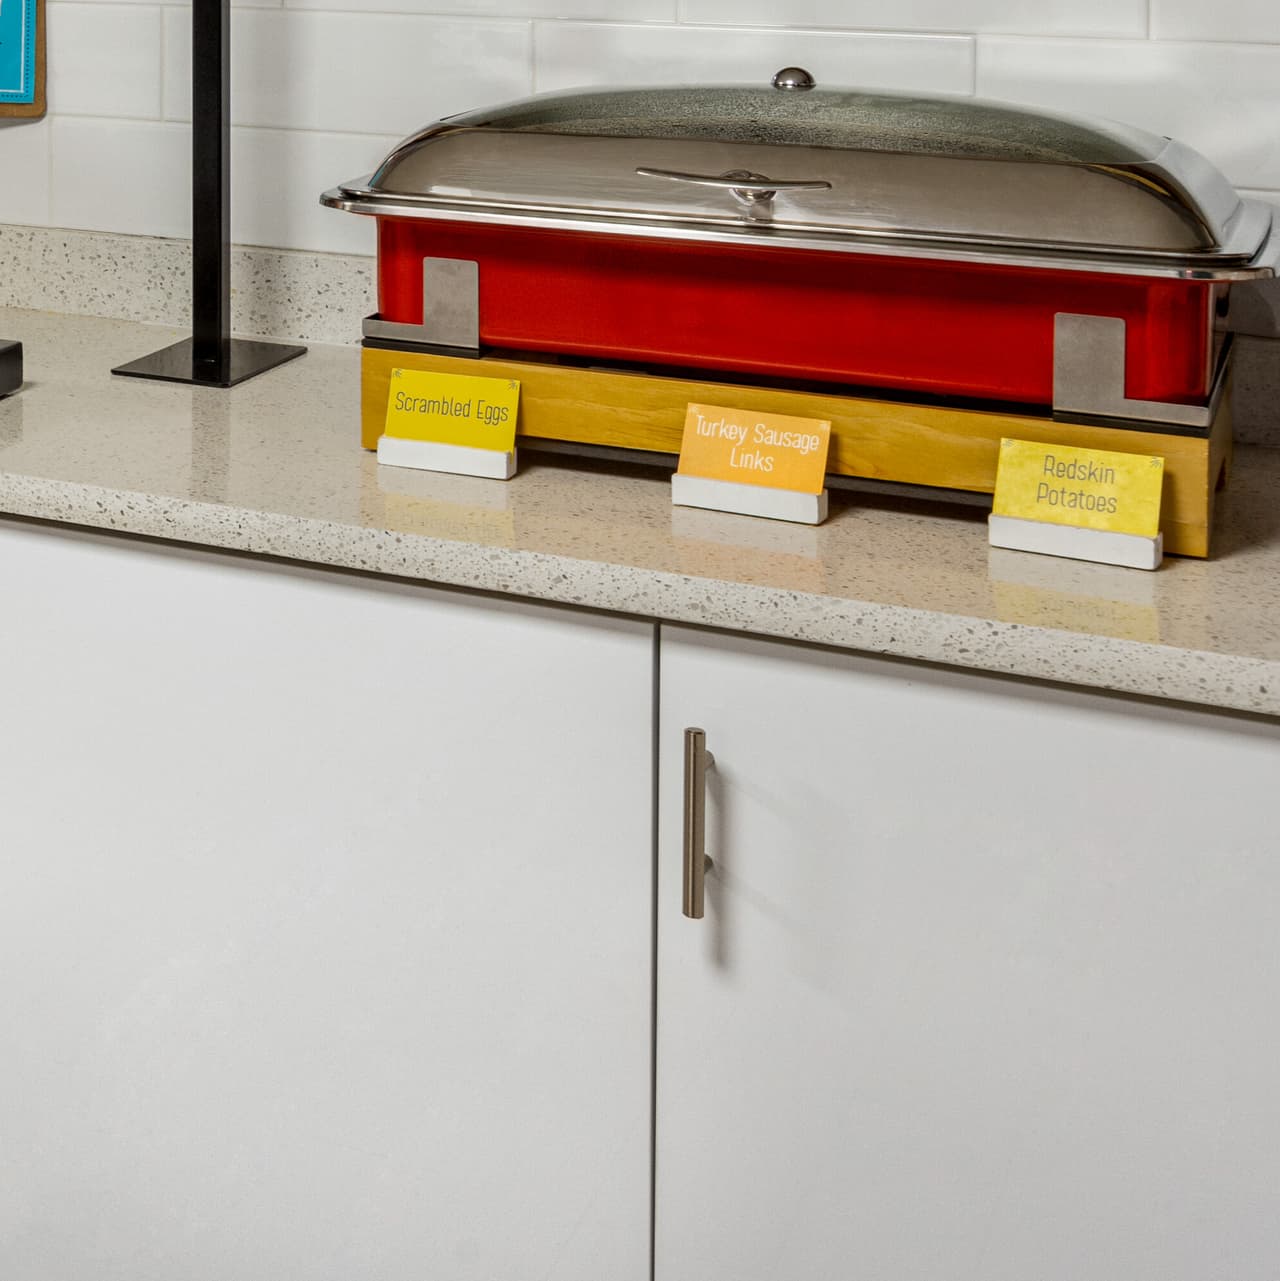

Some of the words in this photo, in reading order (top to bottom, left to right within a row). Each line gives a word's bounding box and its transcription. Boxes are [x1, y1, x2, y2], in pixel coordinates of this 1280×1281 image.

[395, 391, 471, 418] Scrambled
[476, 399, 509, 426] Eggs
[696, 415, 748, 446] Turkey
[753, 423, 820, 455] Sausage
[729, 448, 774, 472] Links
[1043, 455, 1115, 484] Redskin
[1036, 482, 1117, 513] Potatoes
